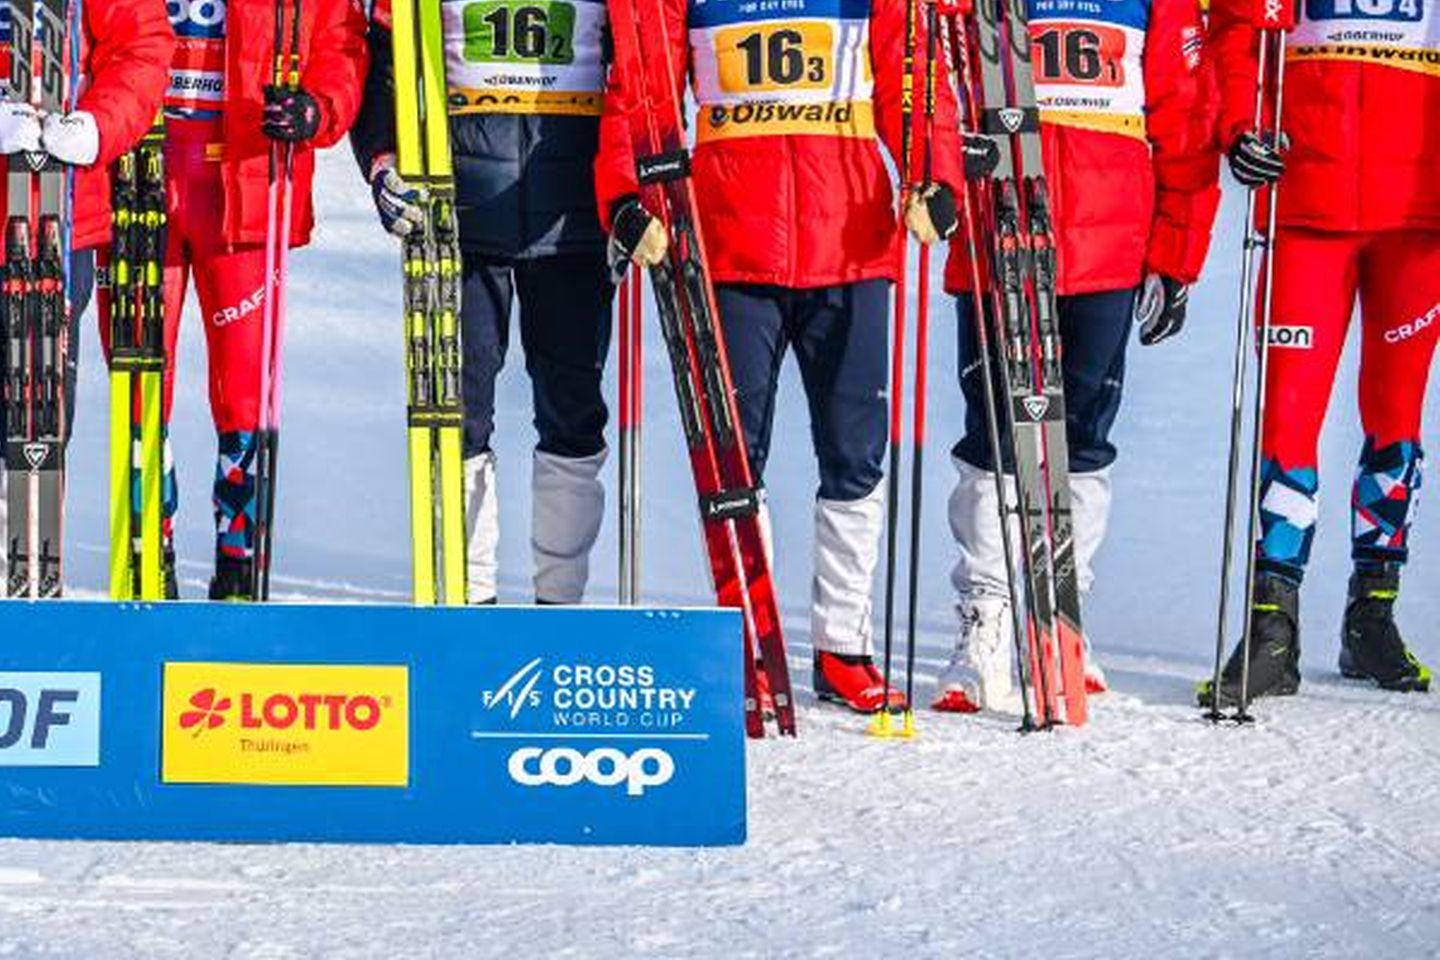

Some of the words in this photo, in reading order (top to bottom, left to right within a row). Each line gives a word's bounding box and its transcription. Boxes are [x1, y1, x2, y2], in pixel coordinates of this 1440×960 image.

[171, 73, 223, 91] BERHO
[553, 665, 655, 686] CROSS
[553, 689, 696, 709] COUNTRY
[241, 694, 384, 732] LOTTO
[553, 711, 630, 726] WORLD
[640, 711, 684, 726] CUP
[508, 746, 675, 795] coop
